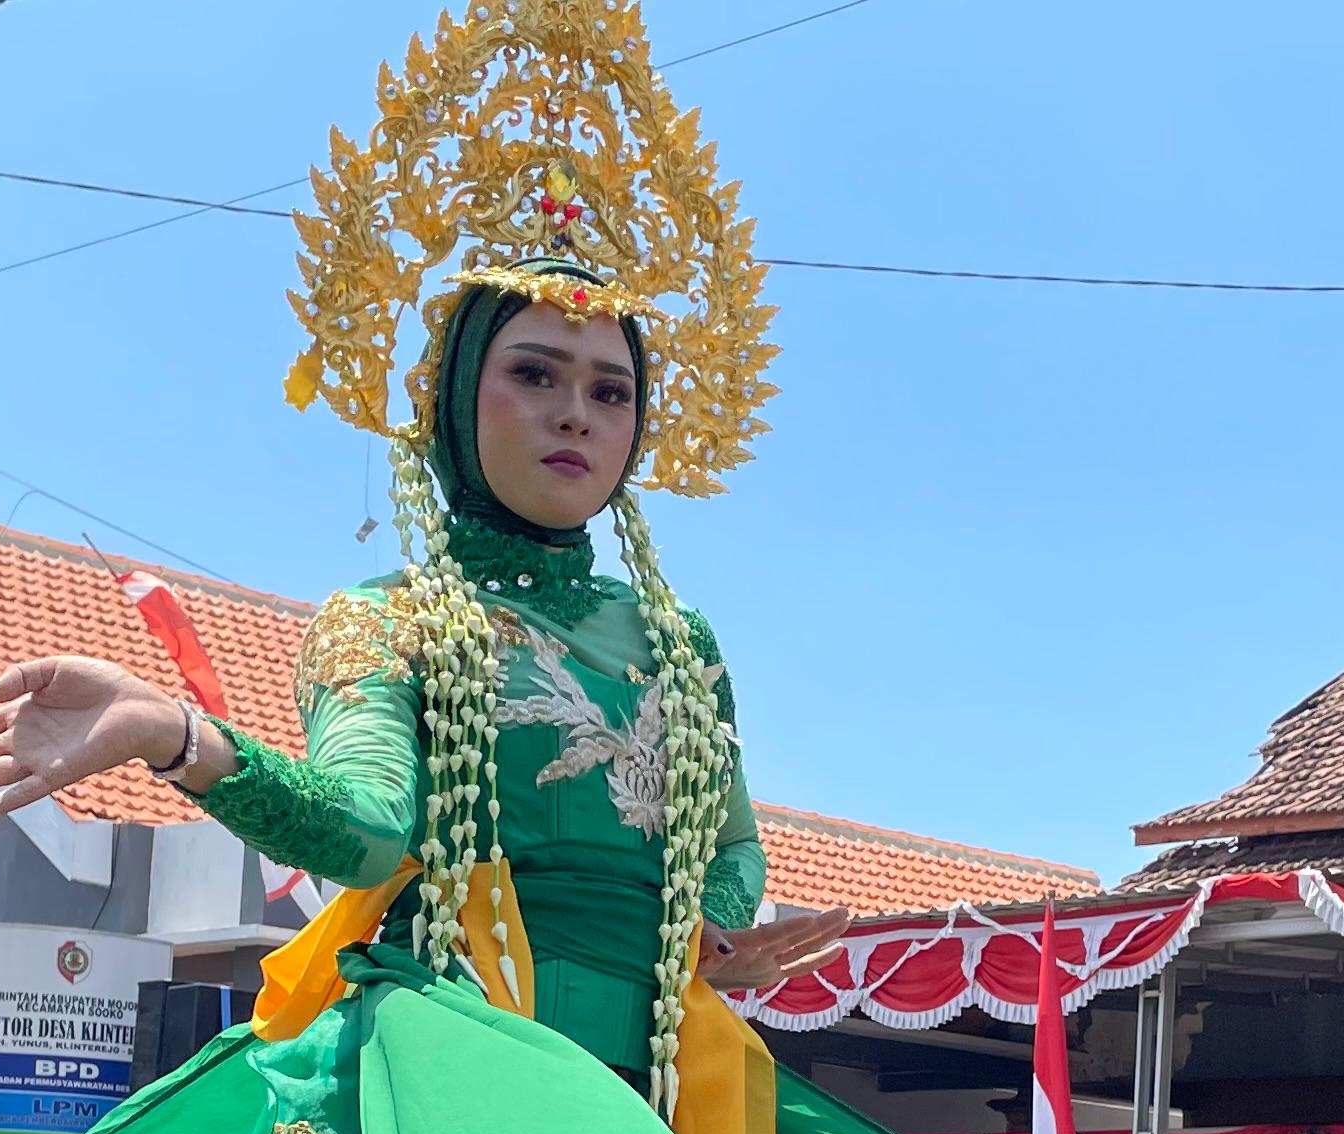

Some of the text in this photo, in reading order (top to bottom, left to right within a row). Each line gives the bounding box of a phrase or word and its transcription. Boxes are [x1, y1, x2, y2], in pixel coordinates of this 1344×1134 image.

[42, 993, 105, 1008] KABUPATEN
[17, 1002, 124, 1020] KECAMATAN SOOKO
[38, 1018, 76, 1040] DESA
[55, 1042, 120, 1055] KLINTEREJO
[35, 1059, 100, 1080] BPD
[24, 1077, 114, 1091] PERMUSYAWARATAN
[32, 1098, 99, 1118] LPM
